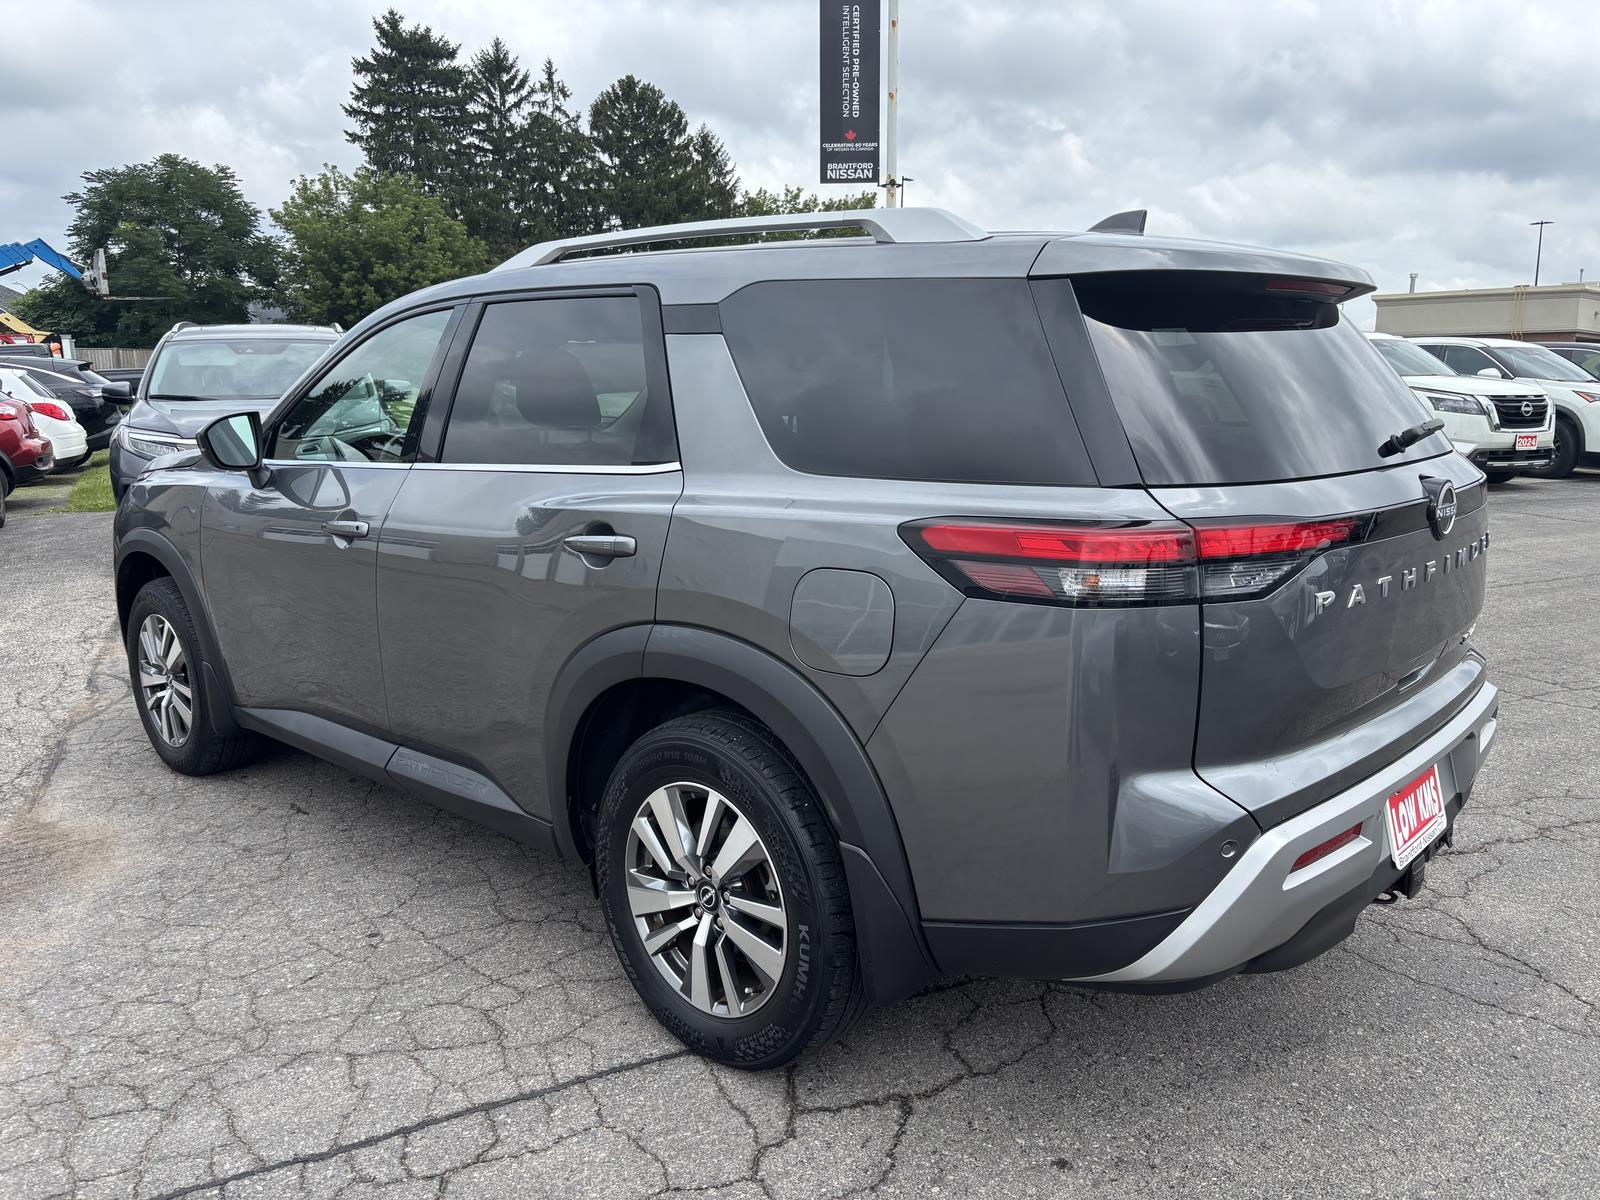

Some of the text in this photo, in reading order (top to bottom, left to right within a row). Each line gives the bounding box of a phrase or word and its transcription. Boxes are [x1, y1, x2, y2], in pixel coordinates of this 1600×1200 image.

[842, 5, 850, 118] INTELLIGENT SELECTION
[852, 5, 860, 118] CERTIFIED PRE-OWNED
[827, 162, 873, 170] BRANTFORD
[827, 169, 873, 179] NISSAN
[1518, 438, 1537, 447] 2024
[1391, 775, 1440, 846] LOW KMS
